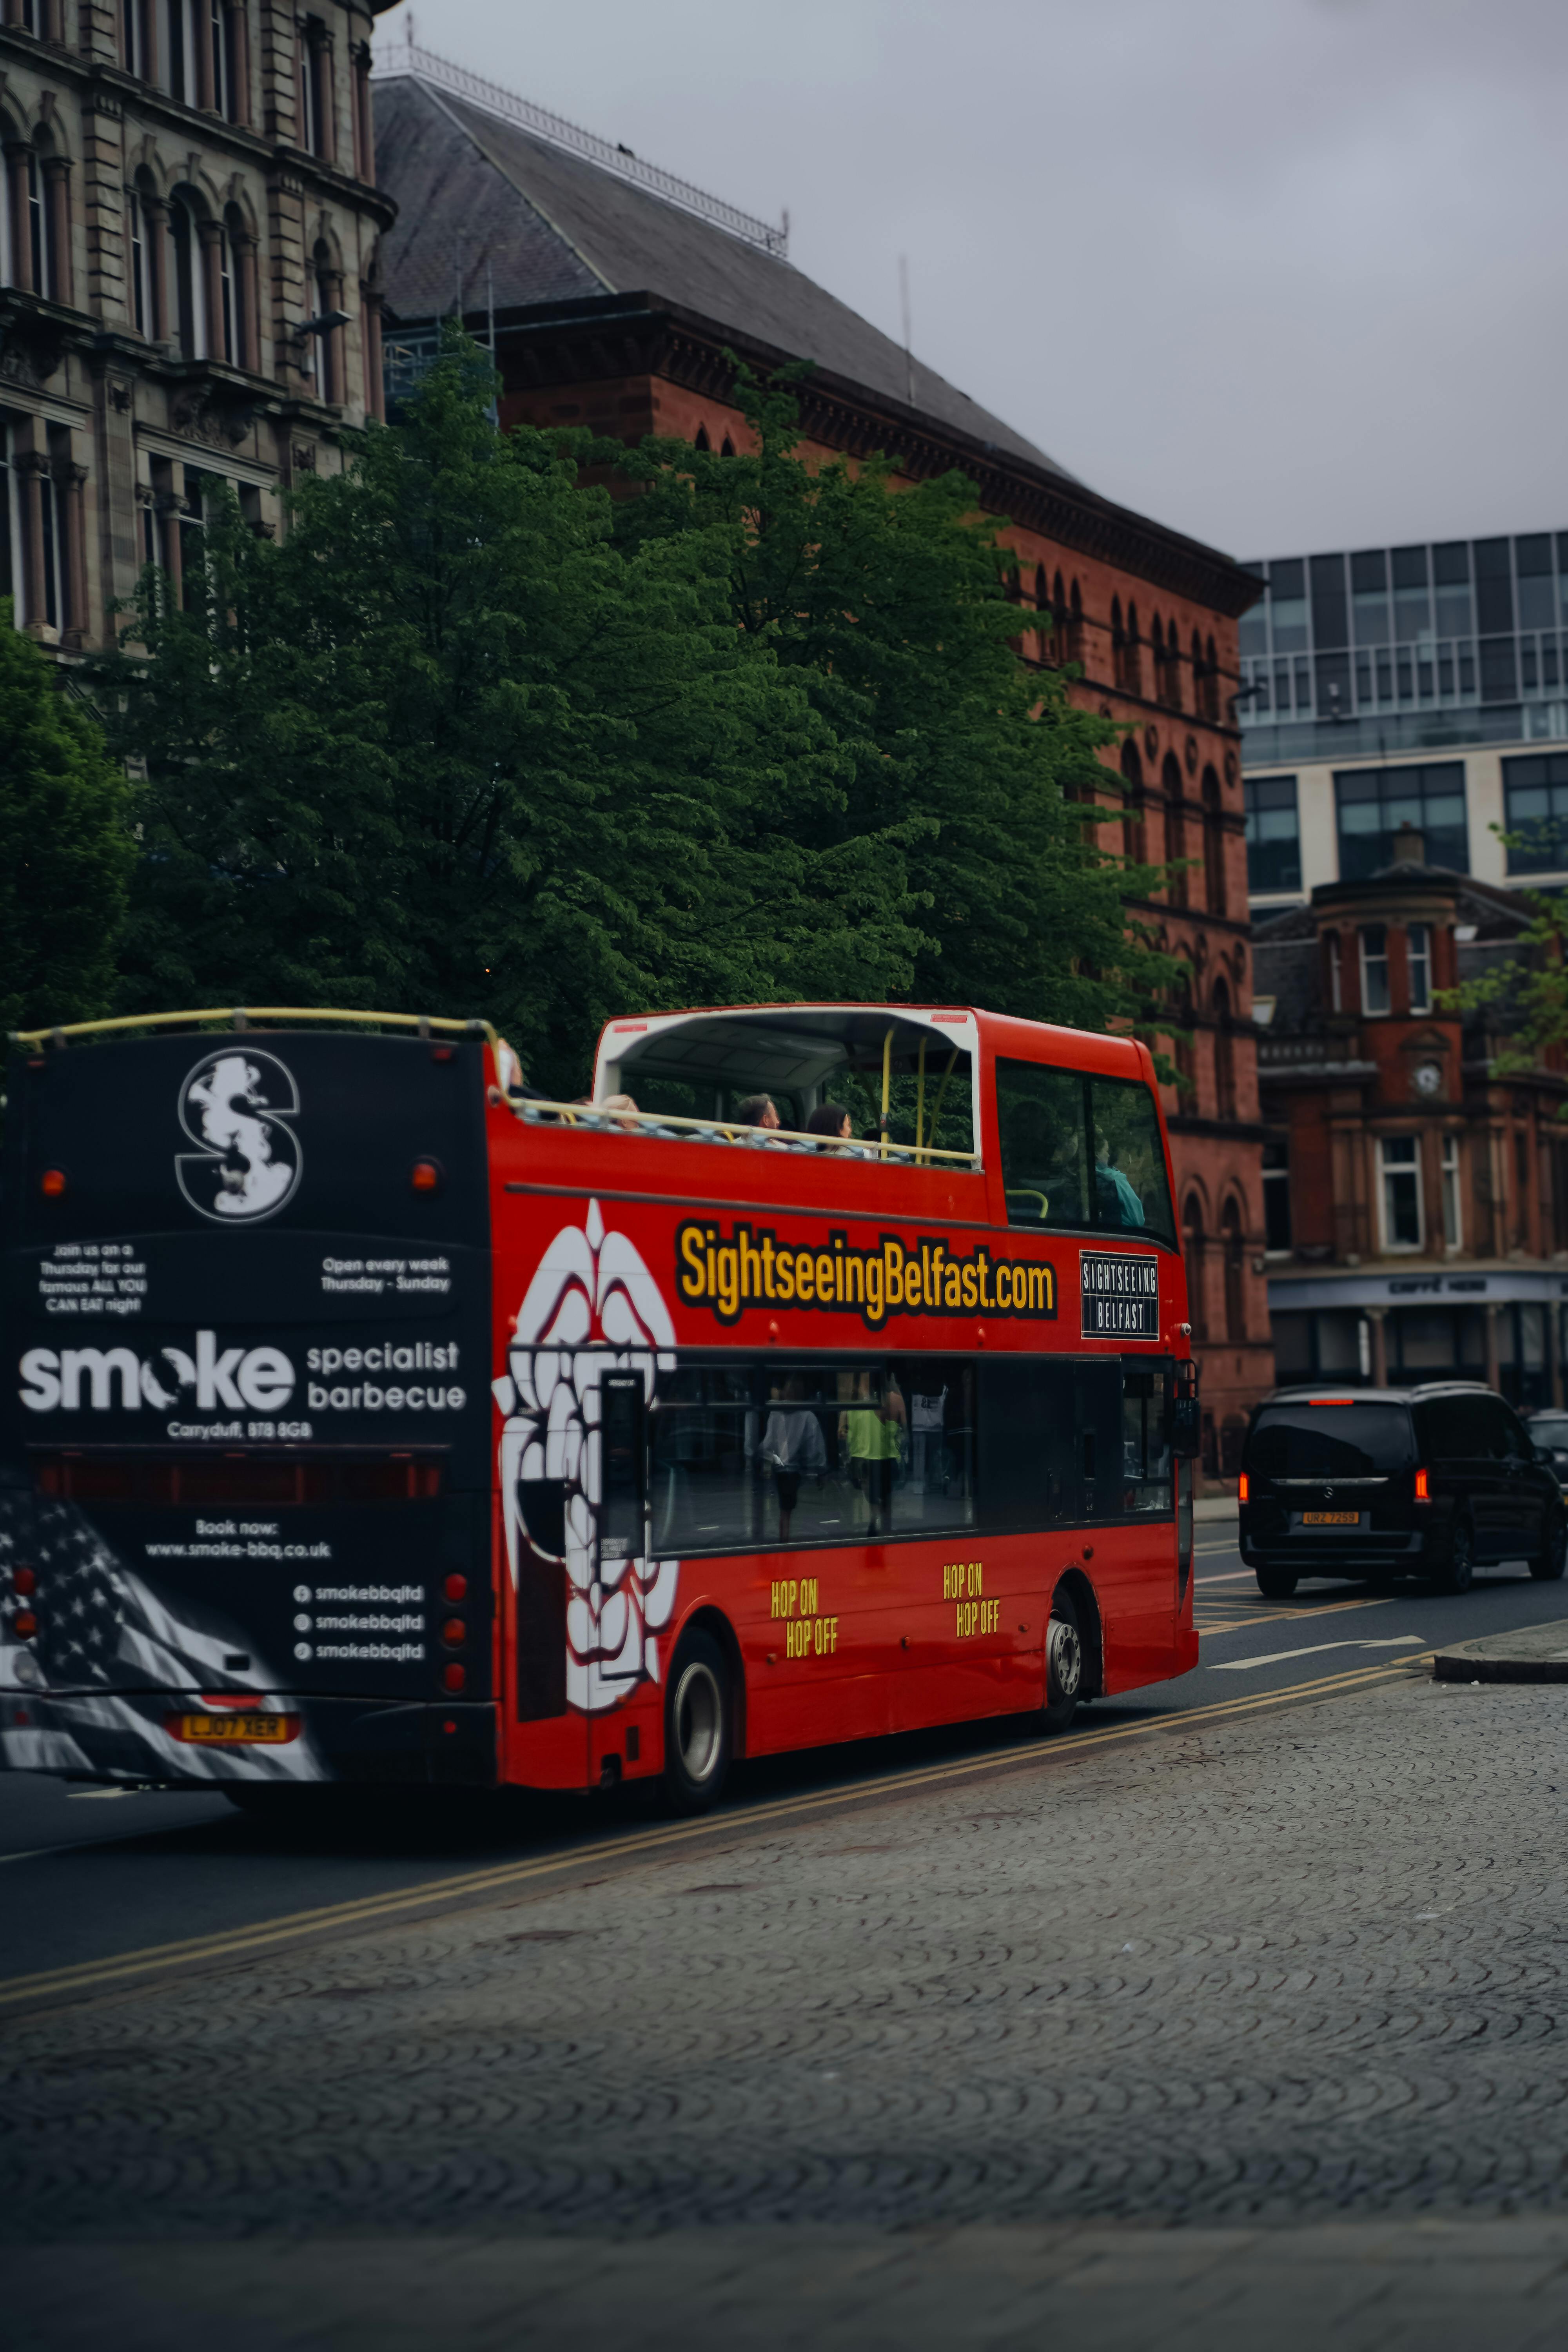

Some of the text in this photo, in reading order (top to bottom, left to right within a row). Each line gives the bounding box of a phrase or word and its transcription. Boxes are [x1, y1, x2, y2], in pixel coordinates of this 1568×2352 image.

[53, 1245, 134, 1257] Join us on a
[40, 1261, 145, 1276] Thursday for our
[323, 1257, 449, 1274] Open every week
[681, 1227, 1053, 1321] SightseeingBelfast.com
[39, 1279, 148, 1294] famous ALL YOU
[321, 1277, 384, 1293] Thursday
[396, 1276, 451, 1292] Sunday
[1083, 1263, 1156, 1293] SIGHTSEEING
[45, 1297, 142, 1315] CAN EAT night
[1098, 1302, 1143, 1329] BELFAST
[307, 1341, 461, 1376] specialist
[18, 1330, 296, 1412] smoke
[308, 1381, 467, 1409] barbecue
[167, 1421, 245, 1439] Carryduff,
[248, 1422, 275, 1437] BT8
[196, 1519, 280, 1535] Book now:
[1307, 1513, 1355, 1522] URZ 7259
[145, 1541, 332, 1560] www.smoke-bbq.co.uk
[944, 1563, 983, 1600] HOP ON
[315, 1584, 425, 1604] smokebbqltd
[771, 1578, 818, 1619] HOP ON
[316, 1613, 425, 1633] smokebbqltd
[957, 1599, 1000, 1637] HOP OFF
[786, 1617, 838, 1658] HOP OFF
[316, 1642, 425, 1662] smokebbqltd
[191, 1716, 278, 1736] LJ07 XER
